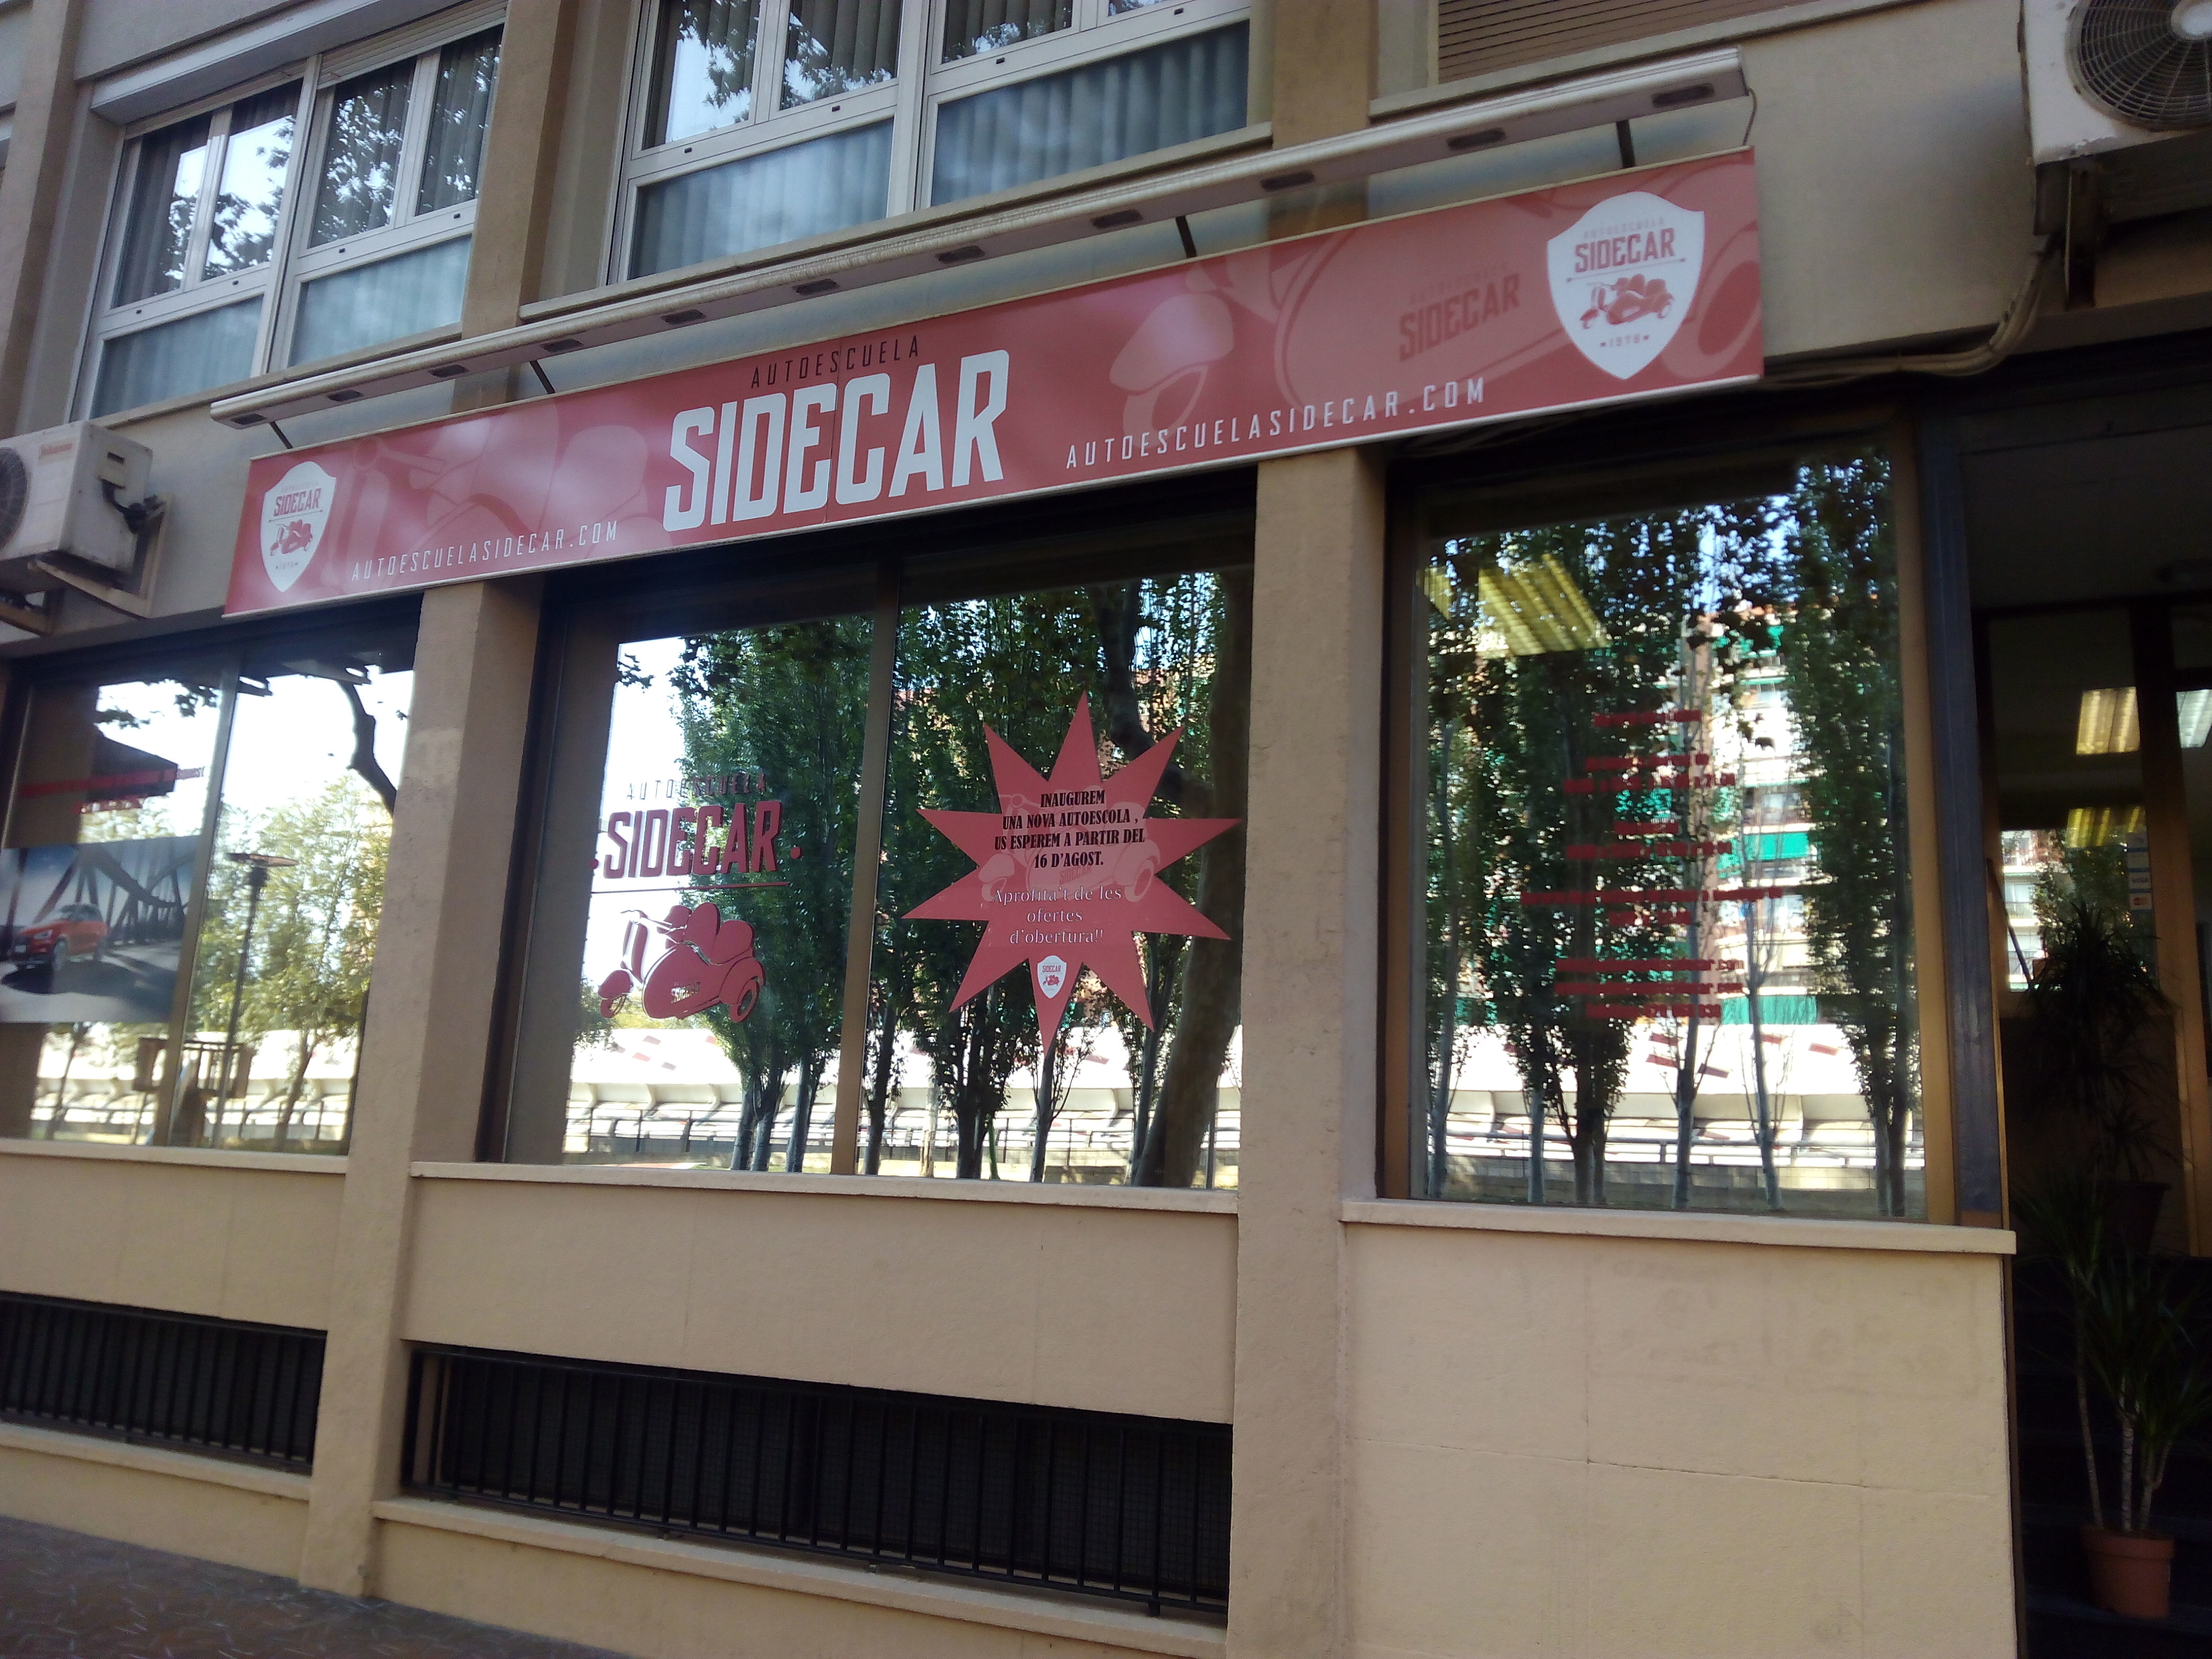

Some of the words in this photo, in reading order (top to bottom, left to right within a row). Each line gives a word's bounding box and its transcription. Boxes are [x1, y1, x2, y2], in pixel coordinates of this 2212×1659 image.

[1575, 228, 1675, 273] SIDECAR
[1399, 273, 1519, 362] SIDECAR
[751, 335, 919, 388] AUTOESCUELA
[662, 349, 1009, 532] SIDECAR
[1066, 377, 1486, 469] AUTOESCUELASIDECAR.COM
[273, 488, 321, 517] SIDECAR
[351, 520, 619, 581] AUTOESCUELASIDECAR.COM
[1041, 790, 1105, 808] INAUGUREM
[603, 800, 783, 879] SIDECAR
[994, 836, 1007, 850] US
[1010, 833, 1061, 849] ESPEREM
[1064, 833, 1071, 846] A
[1075, 830, 1120, 846] PARTIR
[1123, 828, 1145, 843] DEL
[1003, 815, 1022, 830] UNA
[1027, 813, 1055, 828] NOVA
[1034, 854, 1047, 868] 16
[1051, 851, 1104, 868] D'AGOST.
[1075, 886, 1093, 900] de
[1100, 886, 1122, 900] les
[1027, 908, 1083, 922] ofertes
